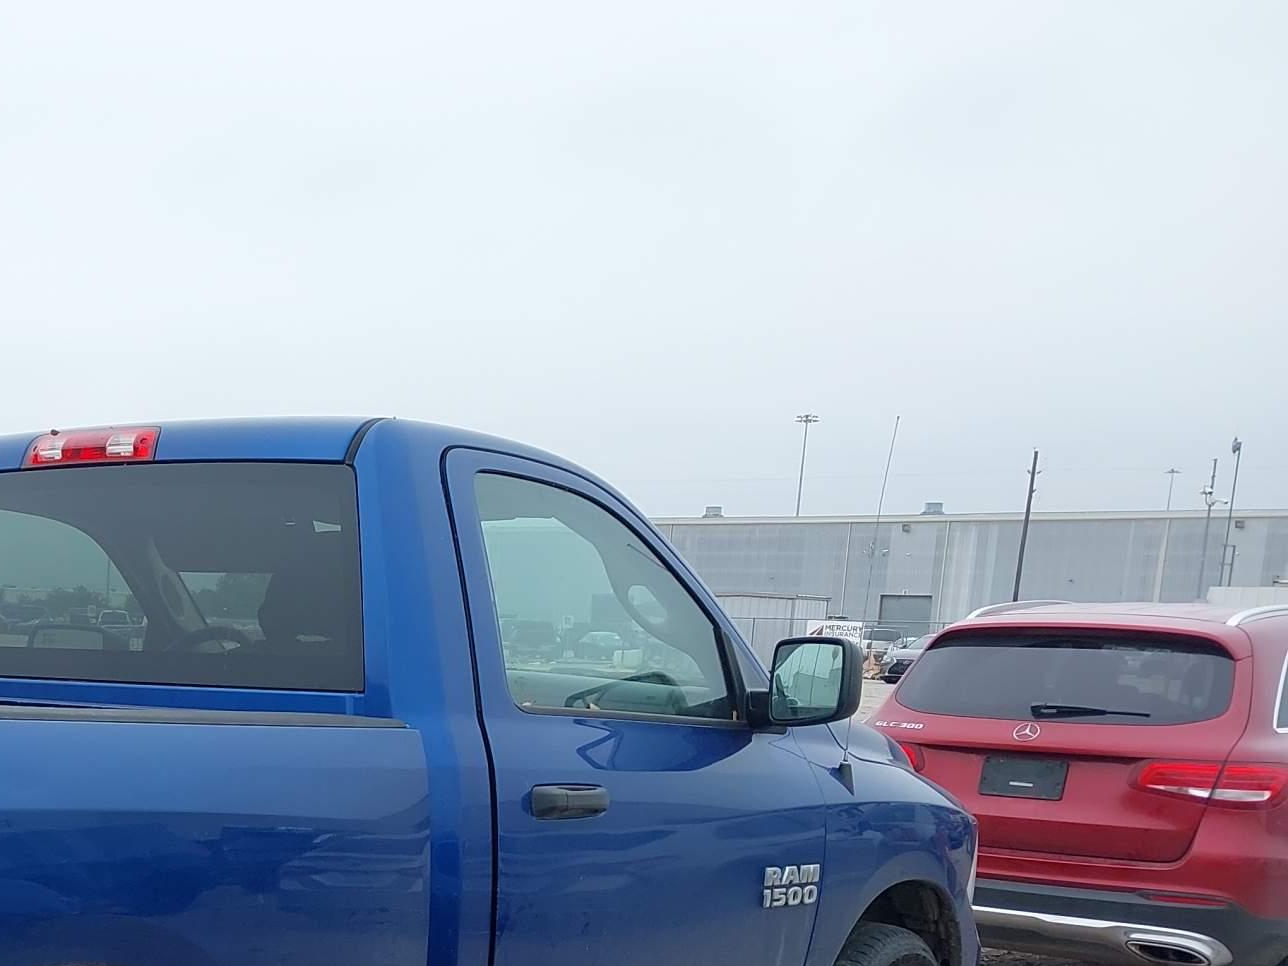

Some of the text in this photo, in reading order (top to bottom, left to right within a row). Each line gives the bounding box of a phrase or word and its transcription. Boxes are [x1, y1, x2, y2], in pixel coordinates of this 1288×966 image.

[824, 624, 863, 632] MERCURY
[764, 864, 820, 886] RAM
[763, 885, 818, 908] 1500
